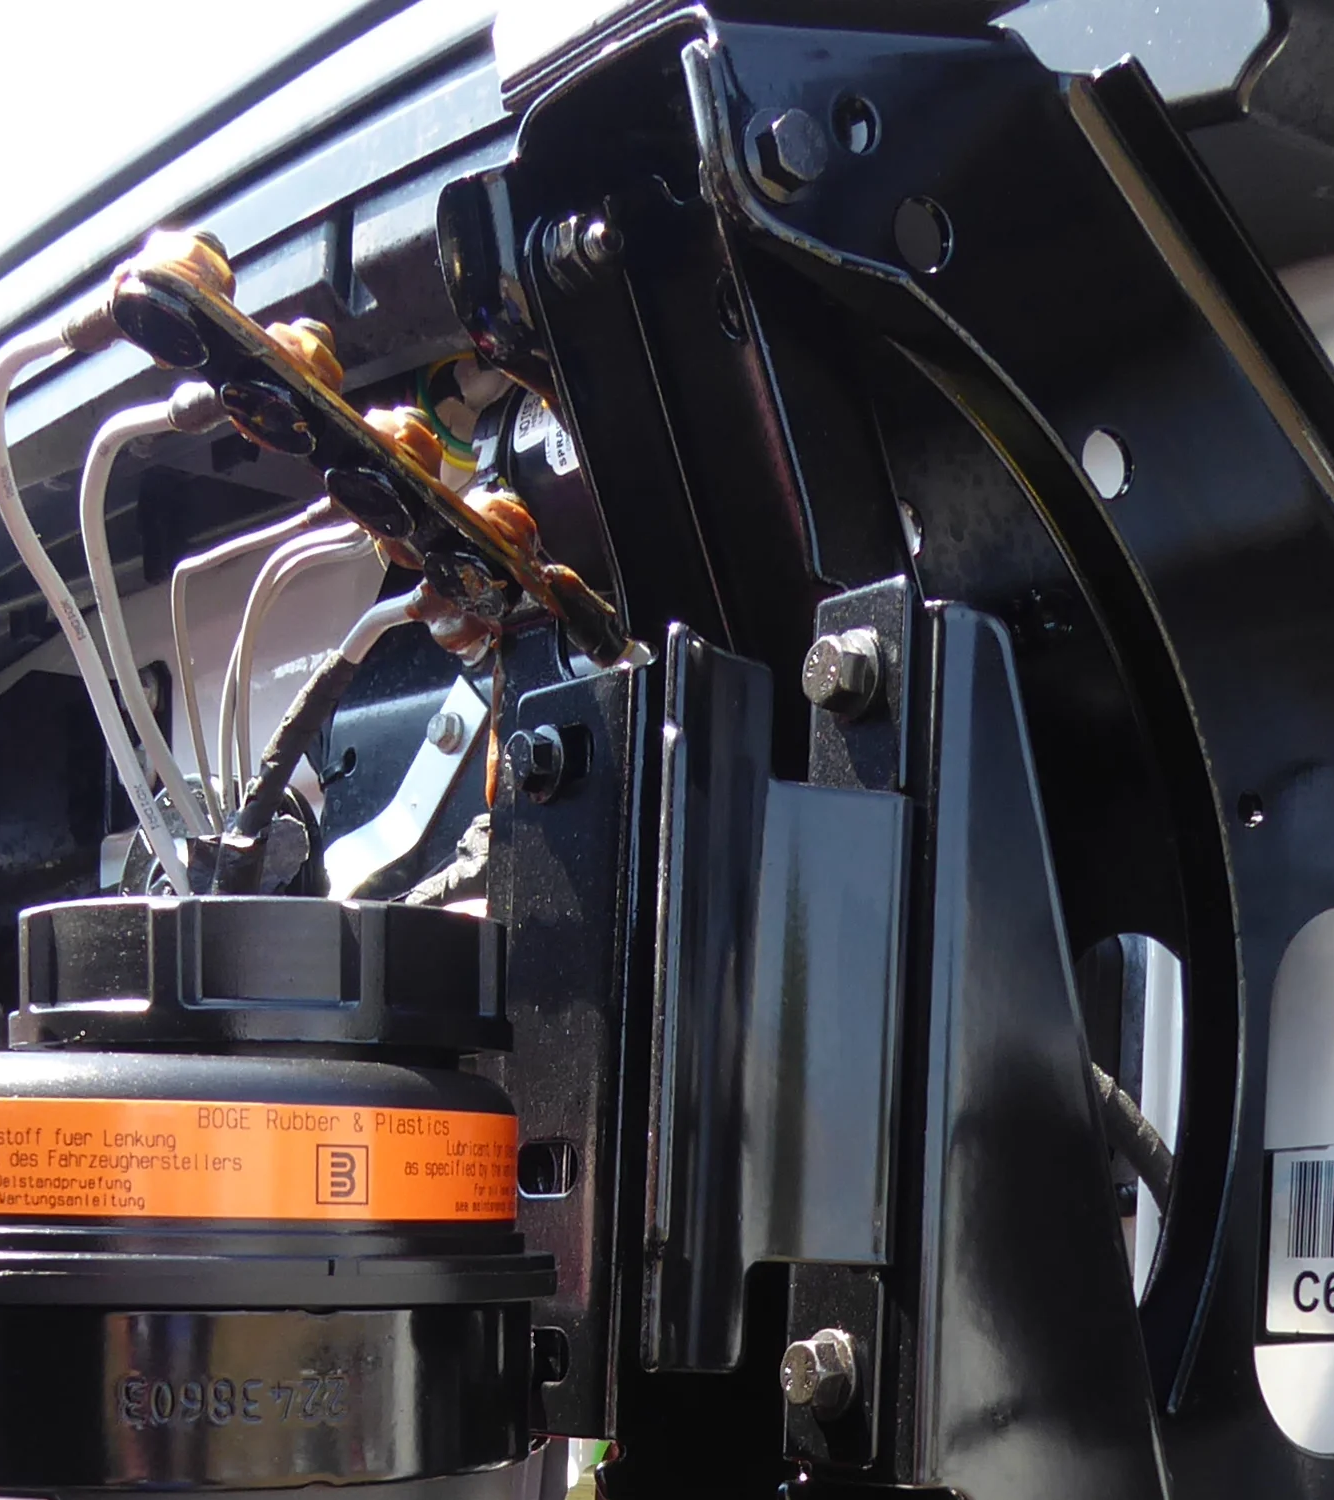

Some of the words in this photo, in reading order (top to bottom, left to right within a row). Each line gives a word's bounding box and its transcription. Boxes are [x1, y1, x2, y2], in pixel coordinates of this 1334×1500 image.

[198, 1107, 251, 1130] BOGE
[267, 1109, 340, 1132] Rubber
[354, 1113, 363, 1132] &
[375, 1113, 450, 1136] Plastics
[55, 1128, 93, 1147] fuer
[103, 1130, 176, 1151] Lenkung
[10, 1152, 38, 1168] des
[47, 1152, 242, 1174] Fahrzeugherstellers
[405, 1162, 419, 1176] as
[425, 1160, 476, 1179] specified
[0, 1193, 146, 1209] Wartungsanleitung
